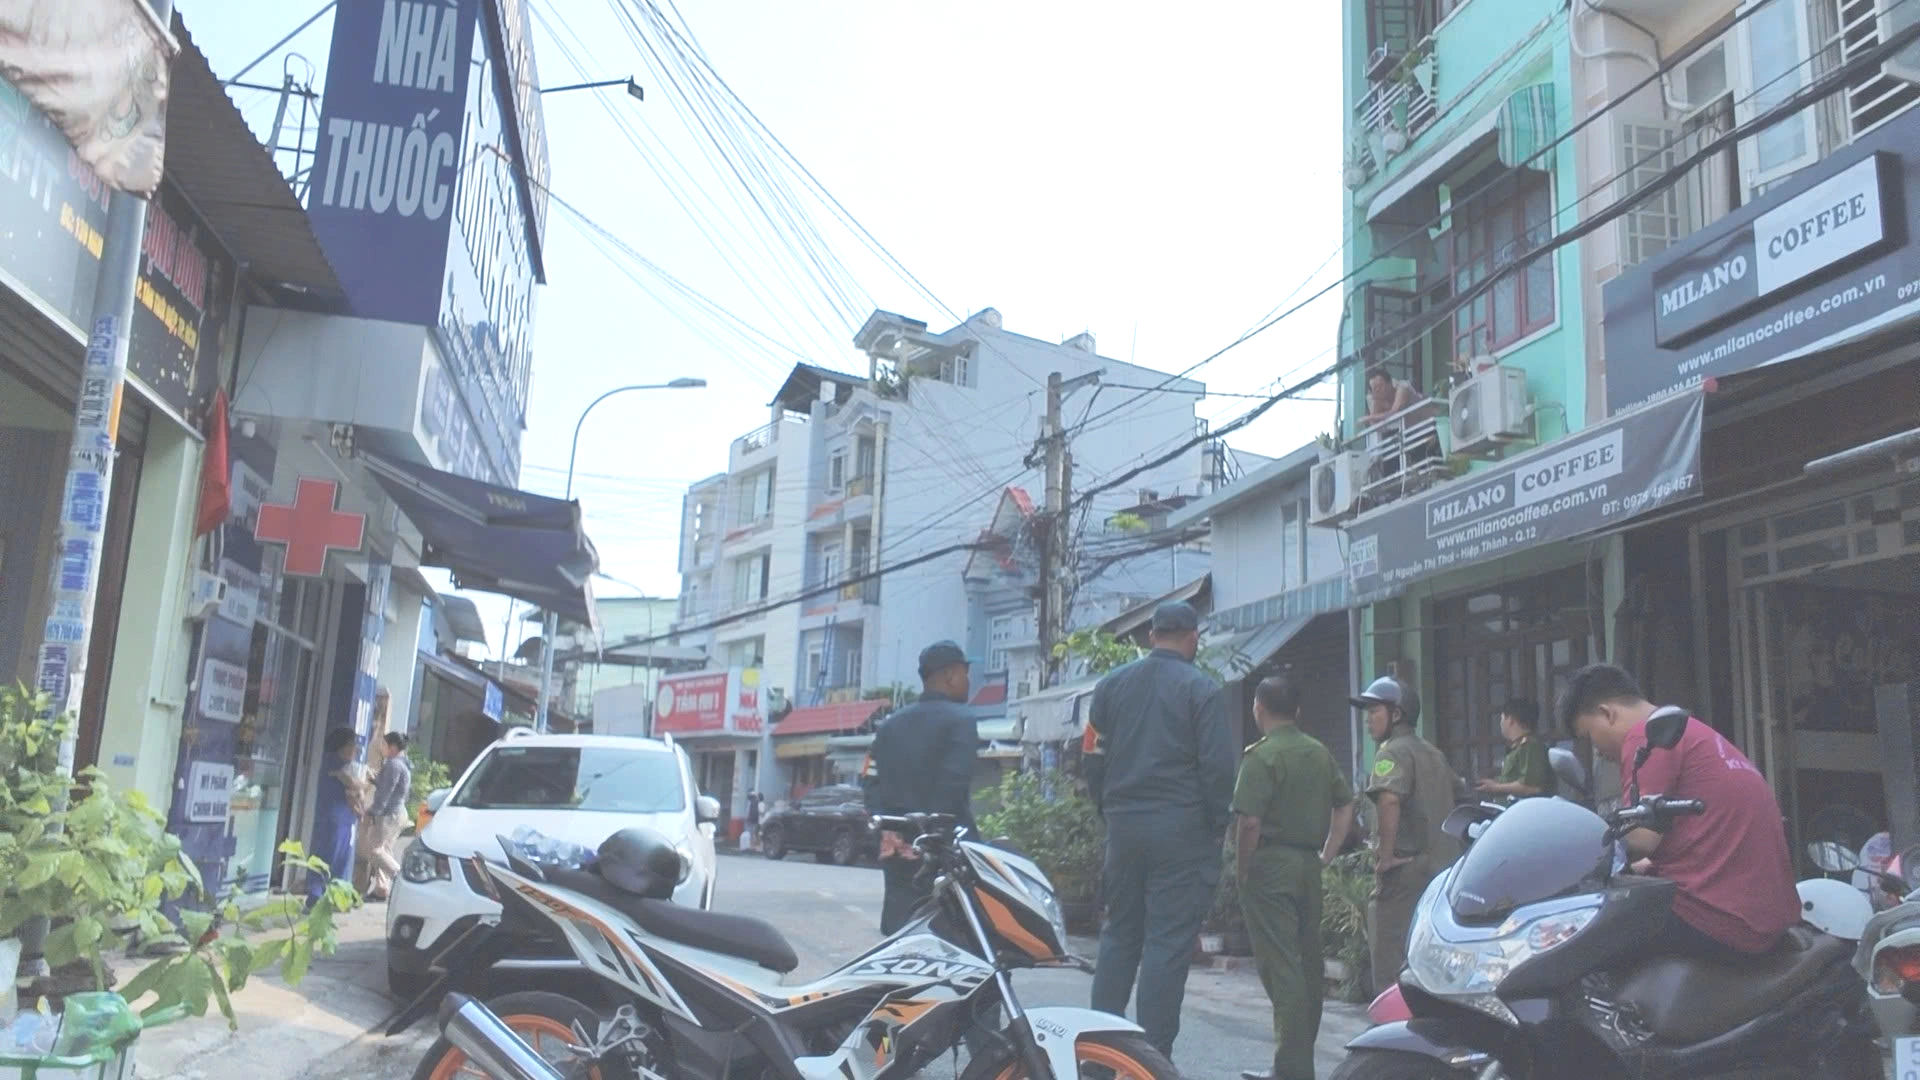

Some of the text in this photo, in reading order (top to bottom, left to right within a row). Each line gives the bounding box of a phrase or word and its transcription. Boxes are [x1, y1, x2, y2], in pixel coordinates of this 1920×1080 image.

[374, 0, 459, 93] NHÀ
[322, 108, 455, 220] THUỐC
[1661, 192, 1866, 317] MILANO COFFEE
[1677, 273, 1886, 376] www.milanocoffee.com.vn
[1432, 443, 1614, 526] MILANO COFFEE
[1436, 482, 1608, 550] www.milanocoffee.com.vn
[1515, 526, 1537, 543] Q.12
[855, 958, 988, 988] SONIC
